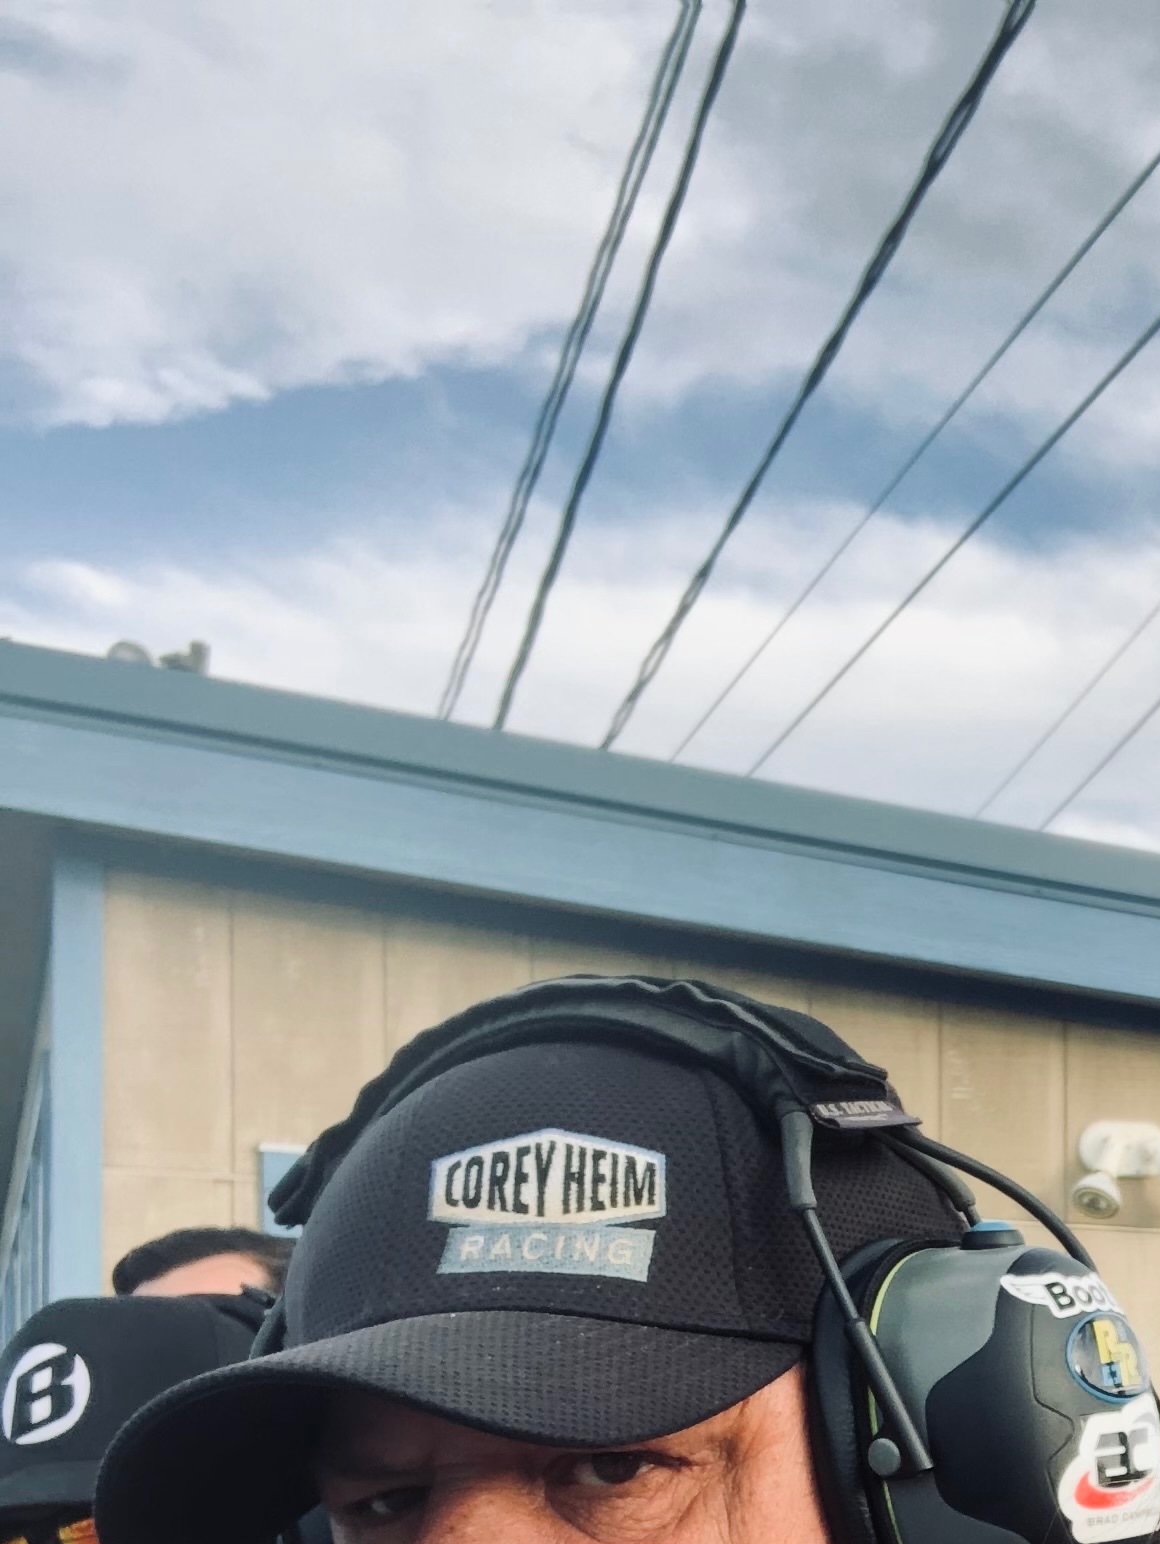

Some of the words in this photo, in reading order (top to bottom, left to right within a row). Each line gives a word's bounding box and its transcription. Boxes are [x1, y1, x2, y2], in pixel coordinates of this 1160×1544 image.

[444, 1140, 556, 1217] COREY
[562, 1143, 656, 1215] HEIM
[459, 1232, 634, 1265] RACING
[8, 1349, 80, 1442] B
[1086, 1513, 1119, 1527] BRAD
